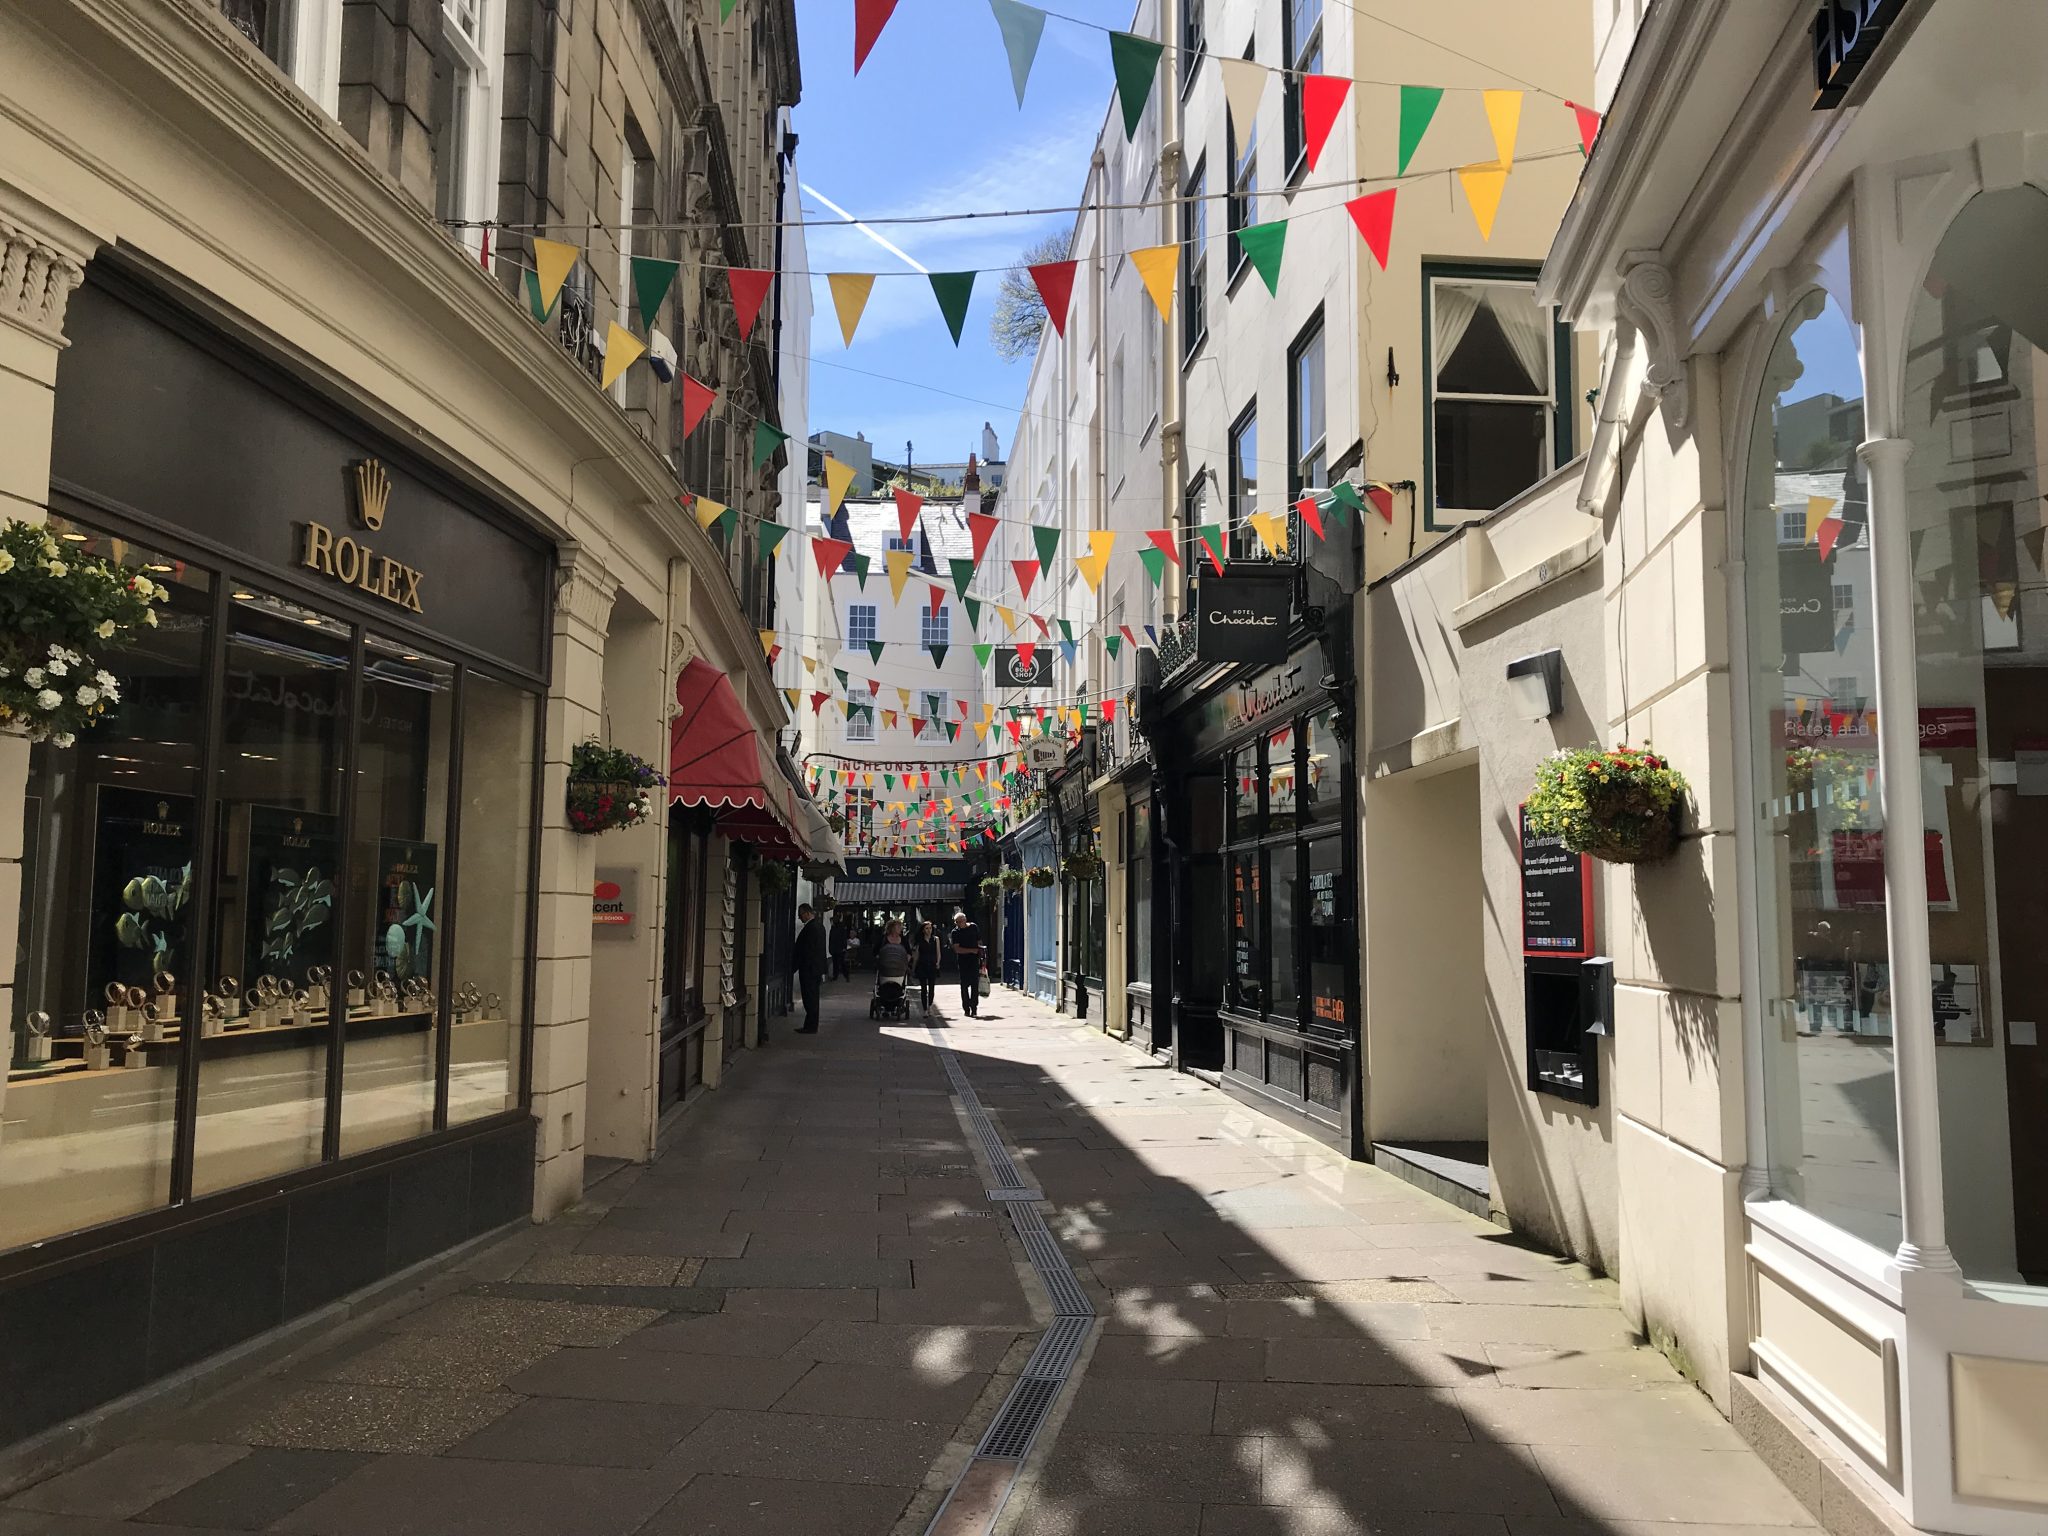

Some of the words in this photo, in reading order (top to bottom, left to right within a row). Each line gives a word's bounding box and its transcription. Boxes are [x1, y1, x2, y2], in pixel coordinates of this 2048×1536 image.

[303, 520, 425, 615] ROLEX
[1209, 610, 1278, 626] Chocolat.
[1838, 722, 1870, 736] and
[143, 821, 182, 836] ROLEX
[1523, 837, 1536, 849] Cash
[1536, 834, 1562, 847] withdrawa
[592, 901, 624, 913] cent
